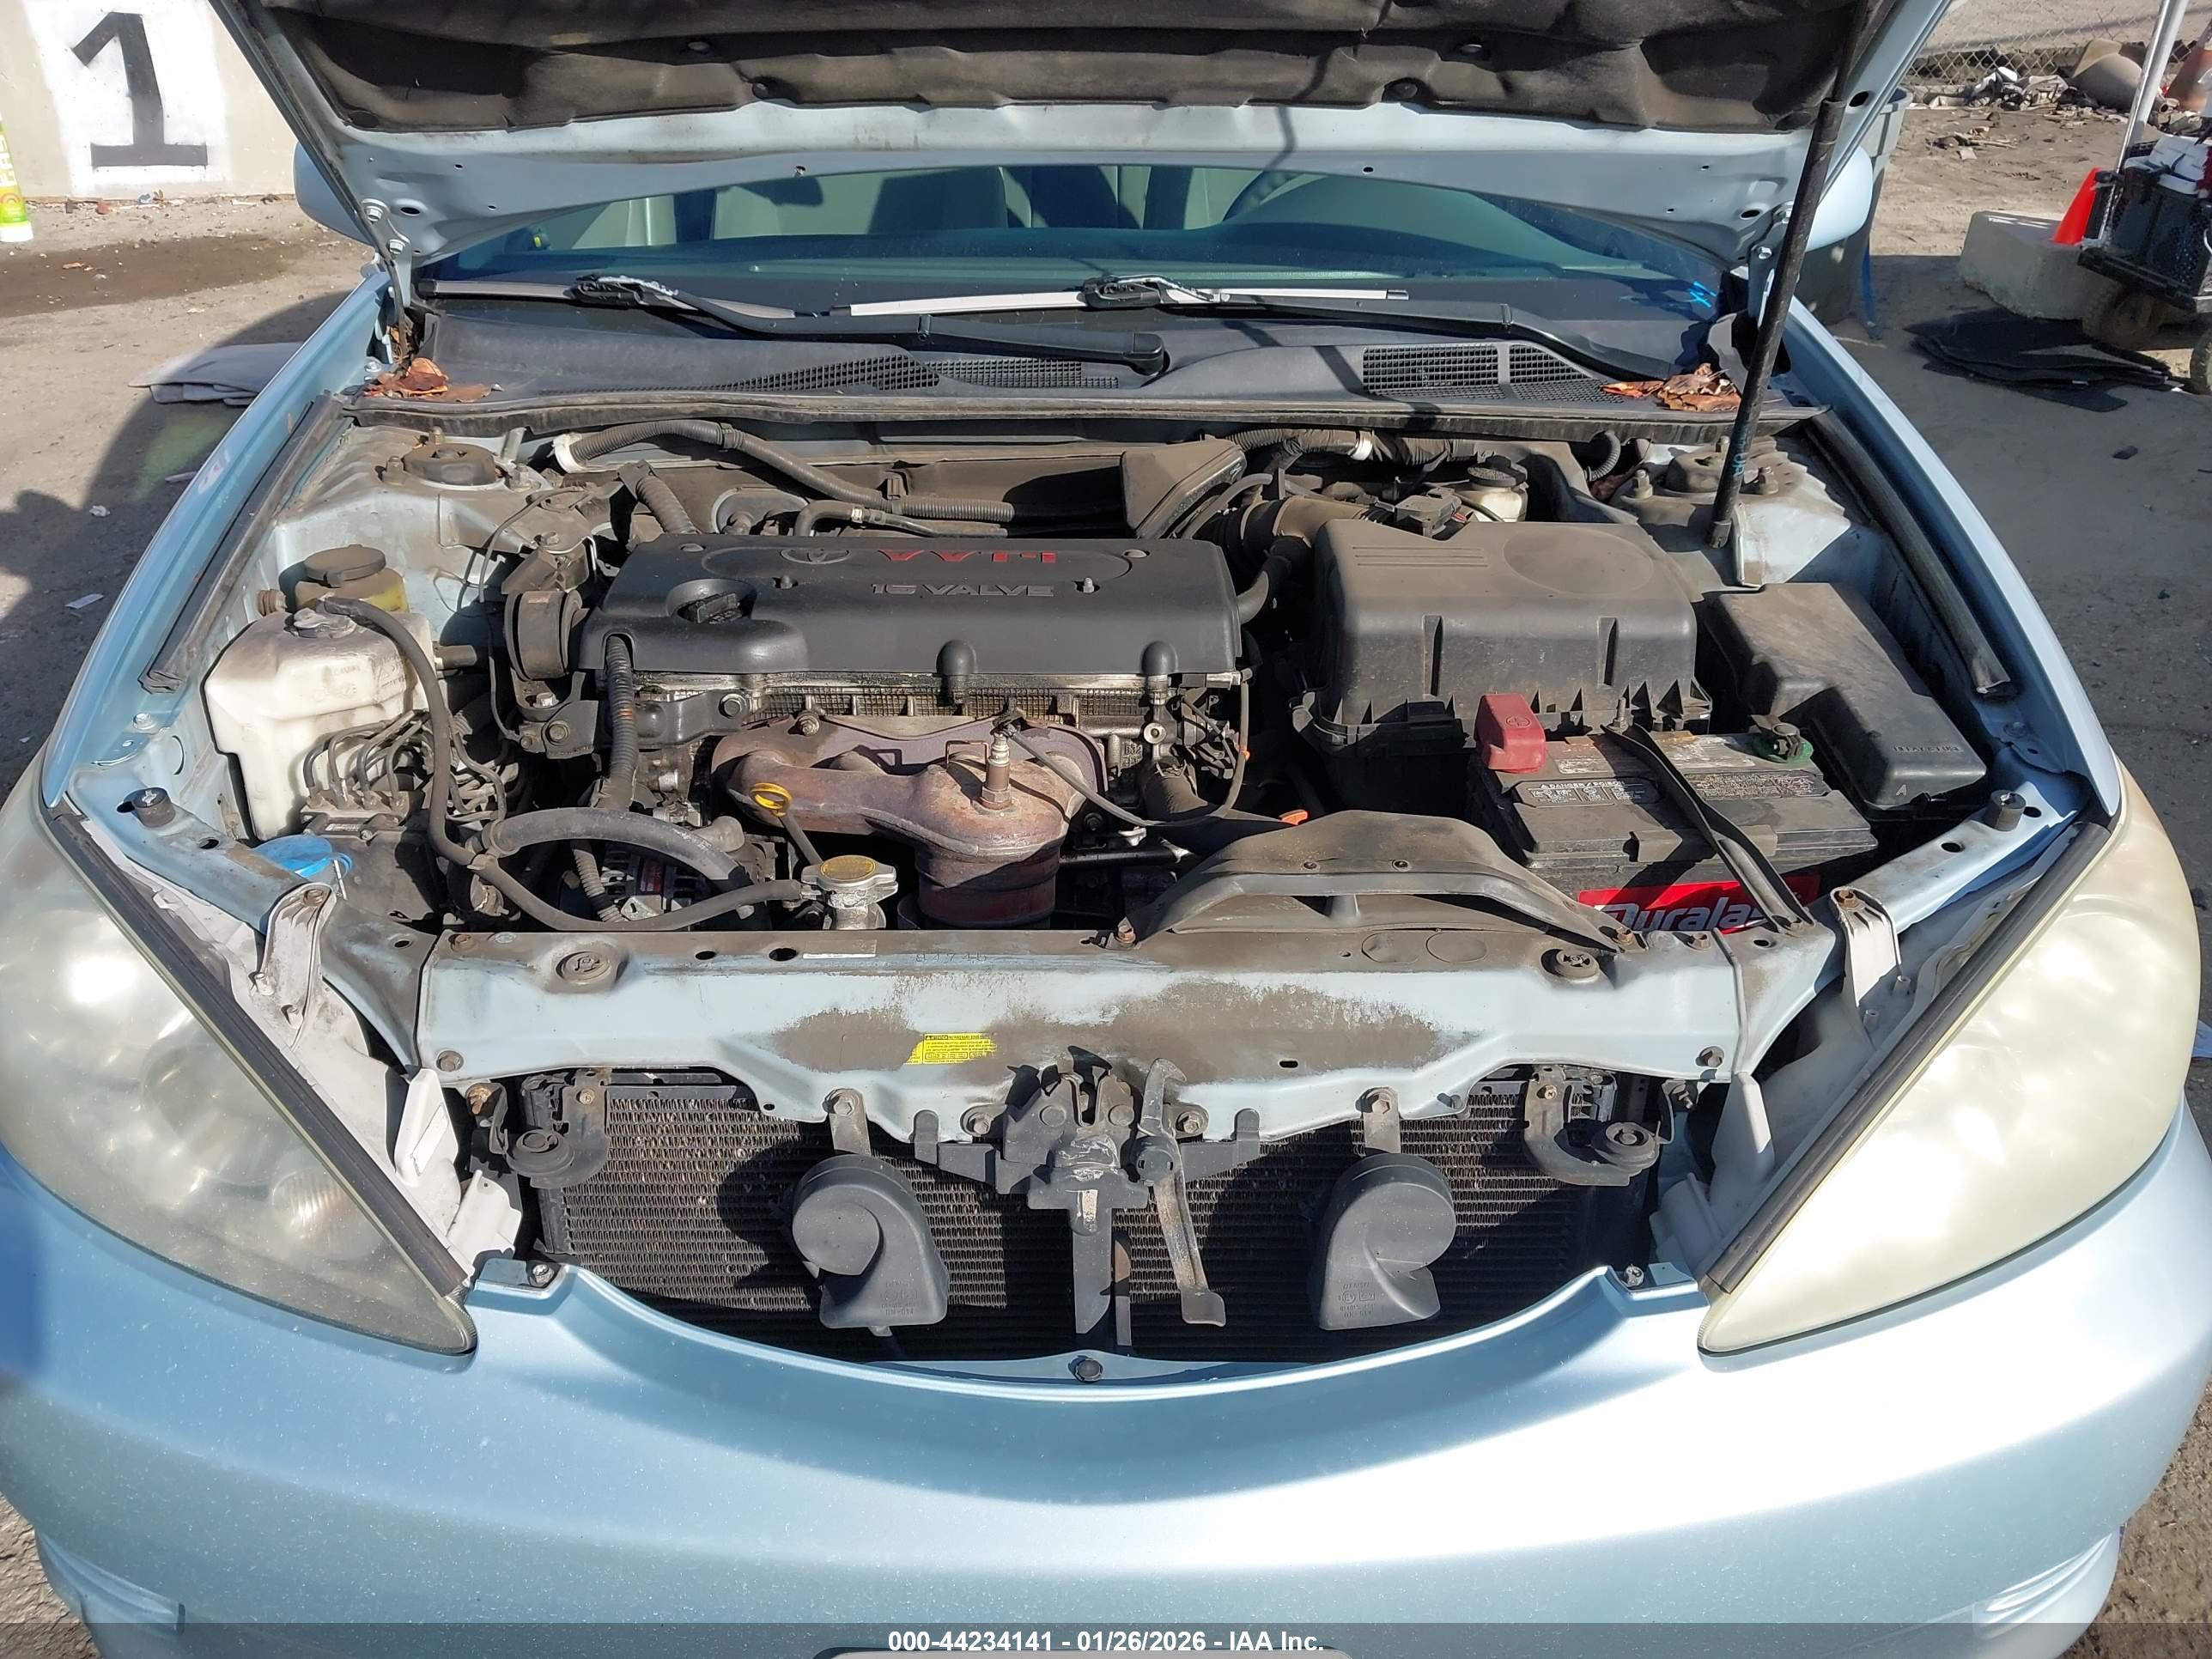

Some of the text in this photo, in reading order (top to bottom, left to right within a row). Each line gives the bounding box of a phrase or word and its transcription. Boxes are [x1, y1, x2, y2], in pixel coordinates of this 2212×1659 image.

[72, 11, 208, 167] 1
[872, 583, 1054, 596] 16 VALVE
[1895, 784, 1906, 796] A
[1602, 897, 1767, 931] Durala
